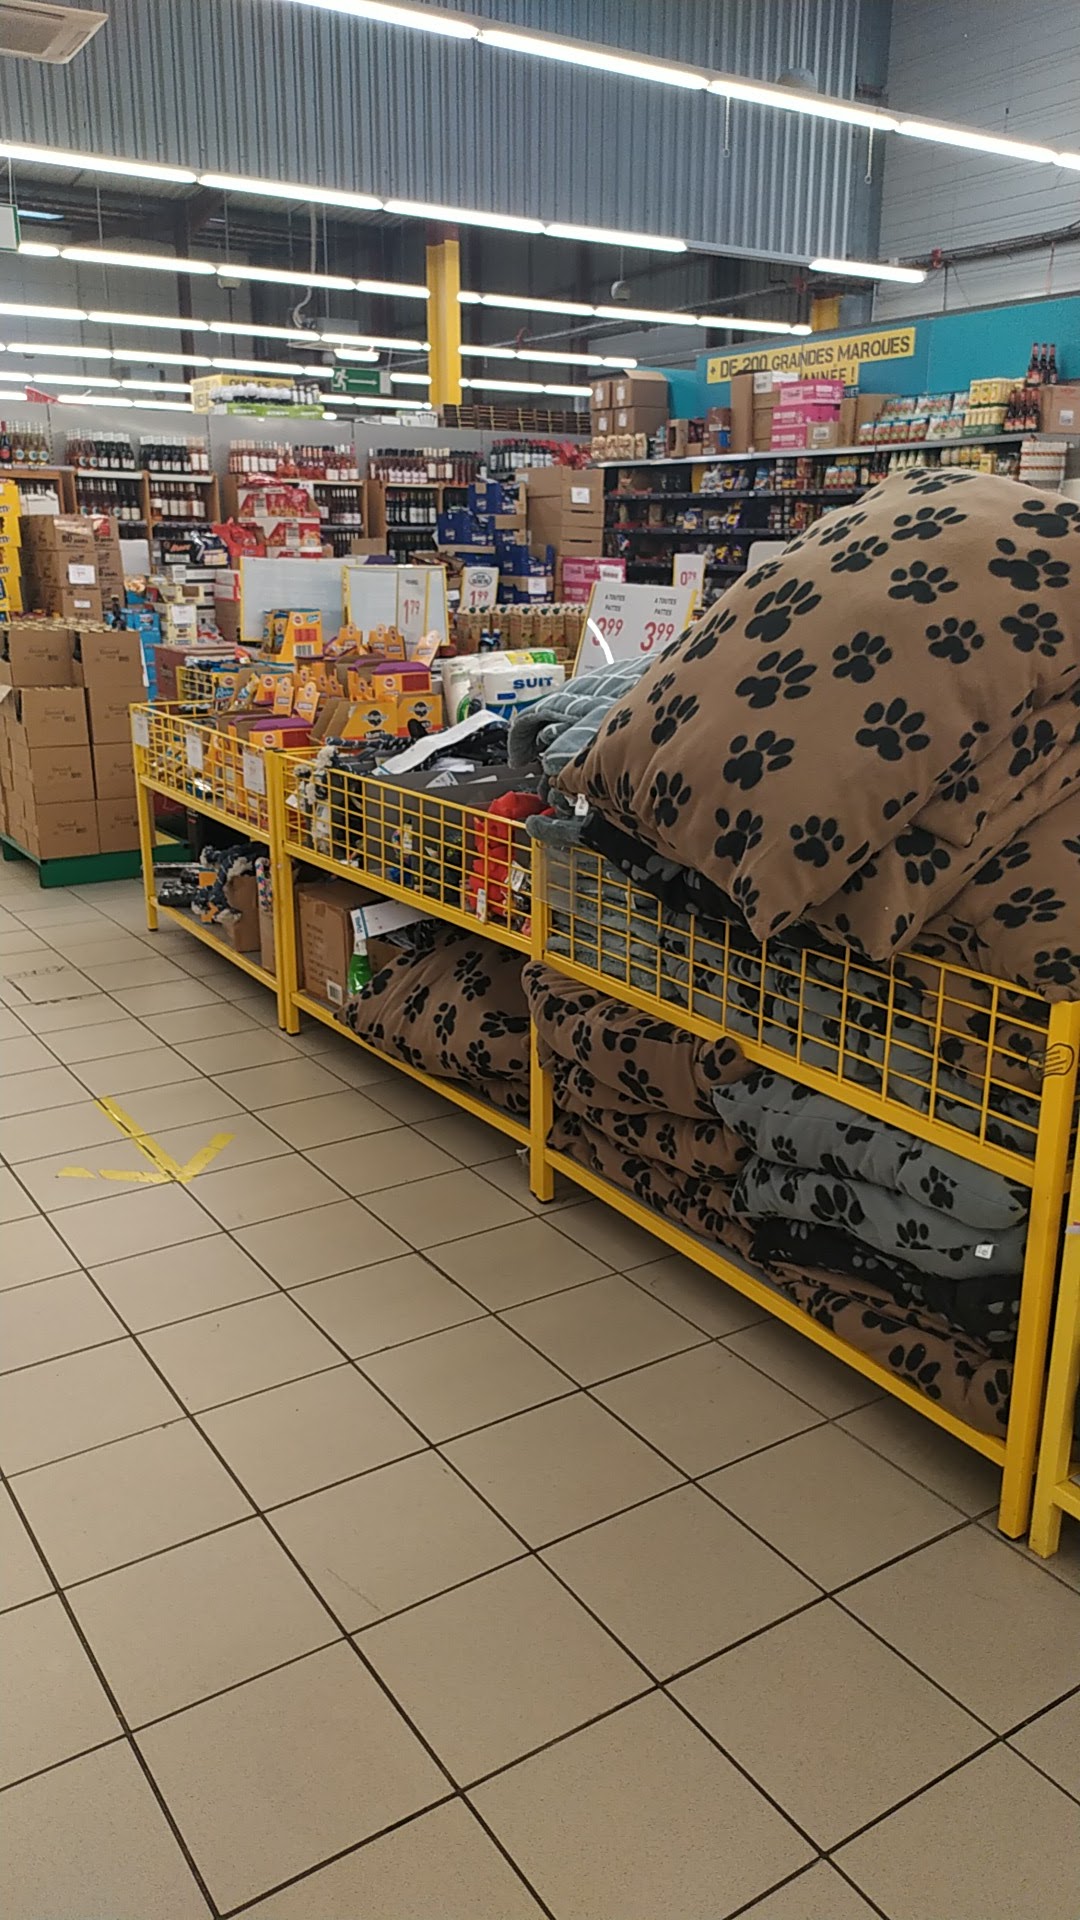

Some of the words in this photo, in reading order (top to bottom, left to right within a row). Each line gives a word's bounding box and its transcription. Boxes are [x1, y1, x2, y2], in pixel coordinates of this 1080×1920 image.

[720, 358, 739, 378] DE
[742, 354, 769, 371] 200
[771, 347, 834, 371] GRANDES
[837, 335, 910, 362] MARQUES
[470, 590, 488, 606] 199
[640, 621, 675, 652] 399
[513, 677, 553, 690] SUIT
